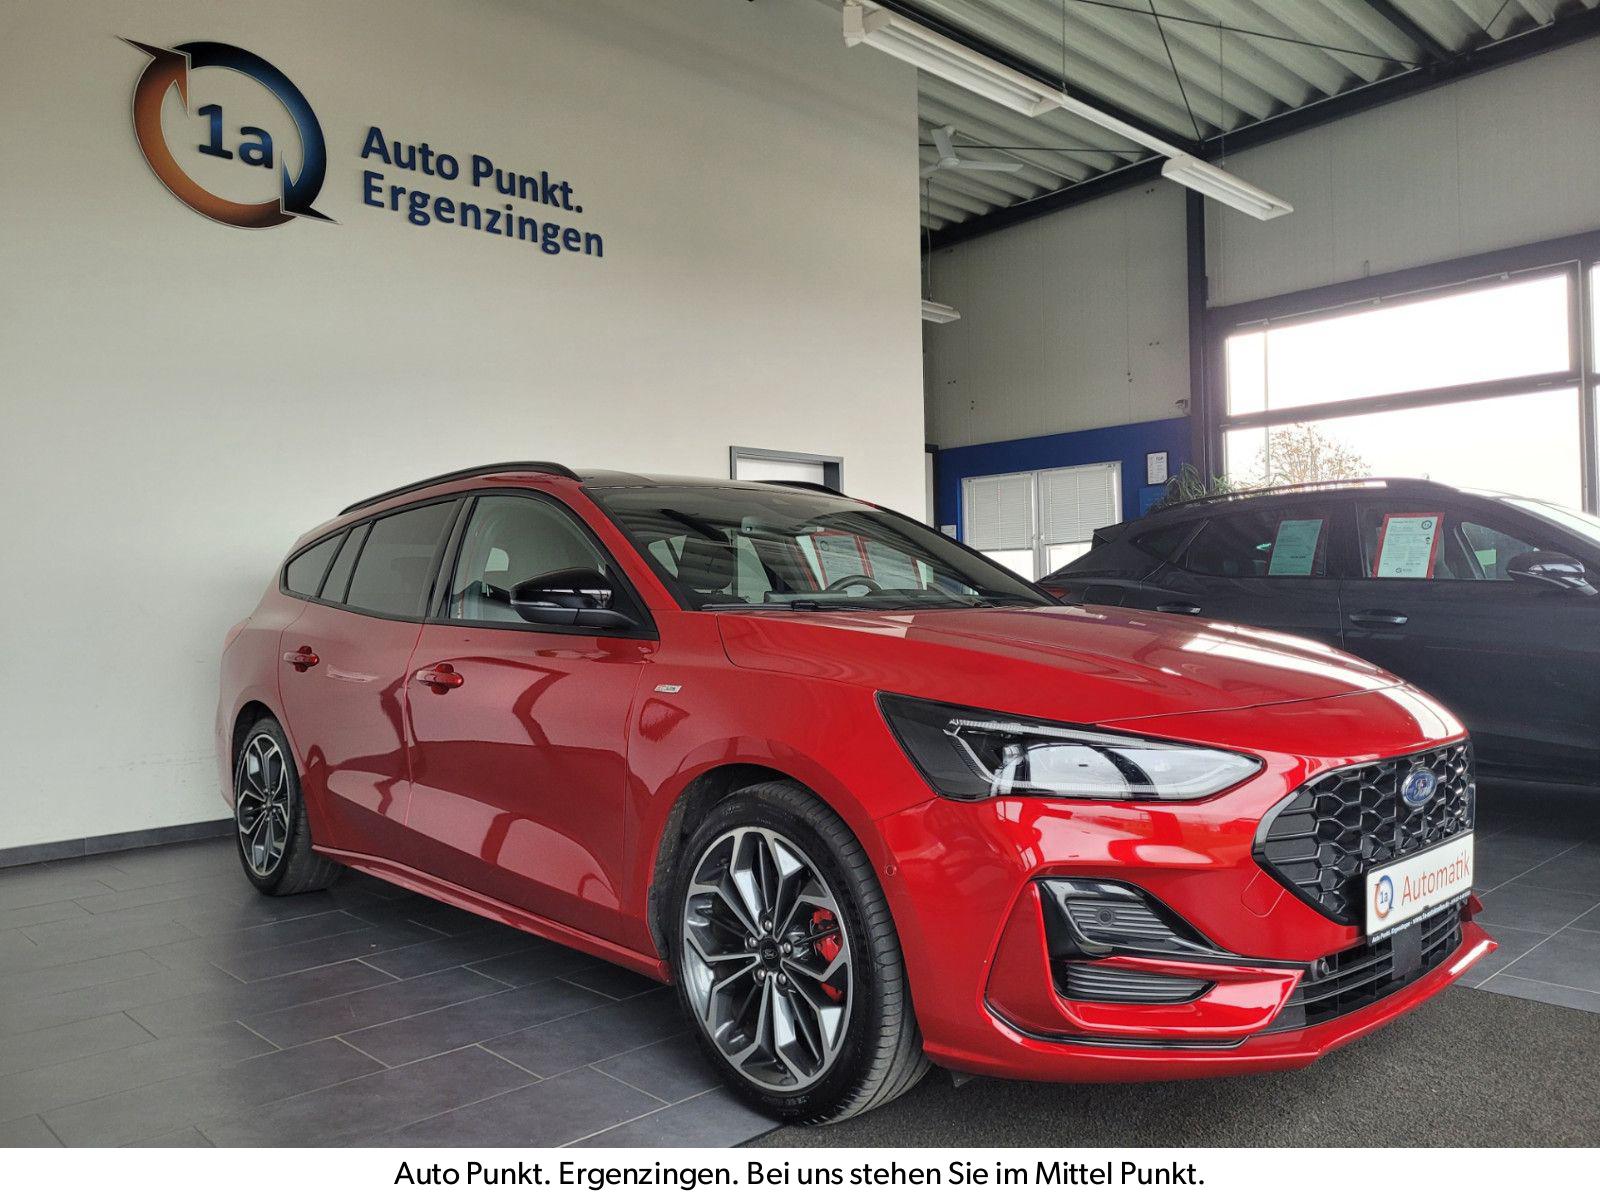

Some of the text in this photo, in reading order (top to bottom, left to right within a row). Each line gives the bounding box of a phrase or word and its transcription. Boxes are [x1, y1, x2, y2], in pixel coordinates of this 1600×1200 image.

[197, 103, 274, 170] 1a
[360, 126, 584, 214] Auto Punkt.
[363, 169, 604, 258] Ergenzingen
[1402, 849, 1471, 907] Automatik
